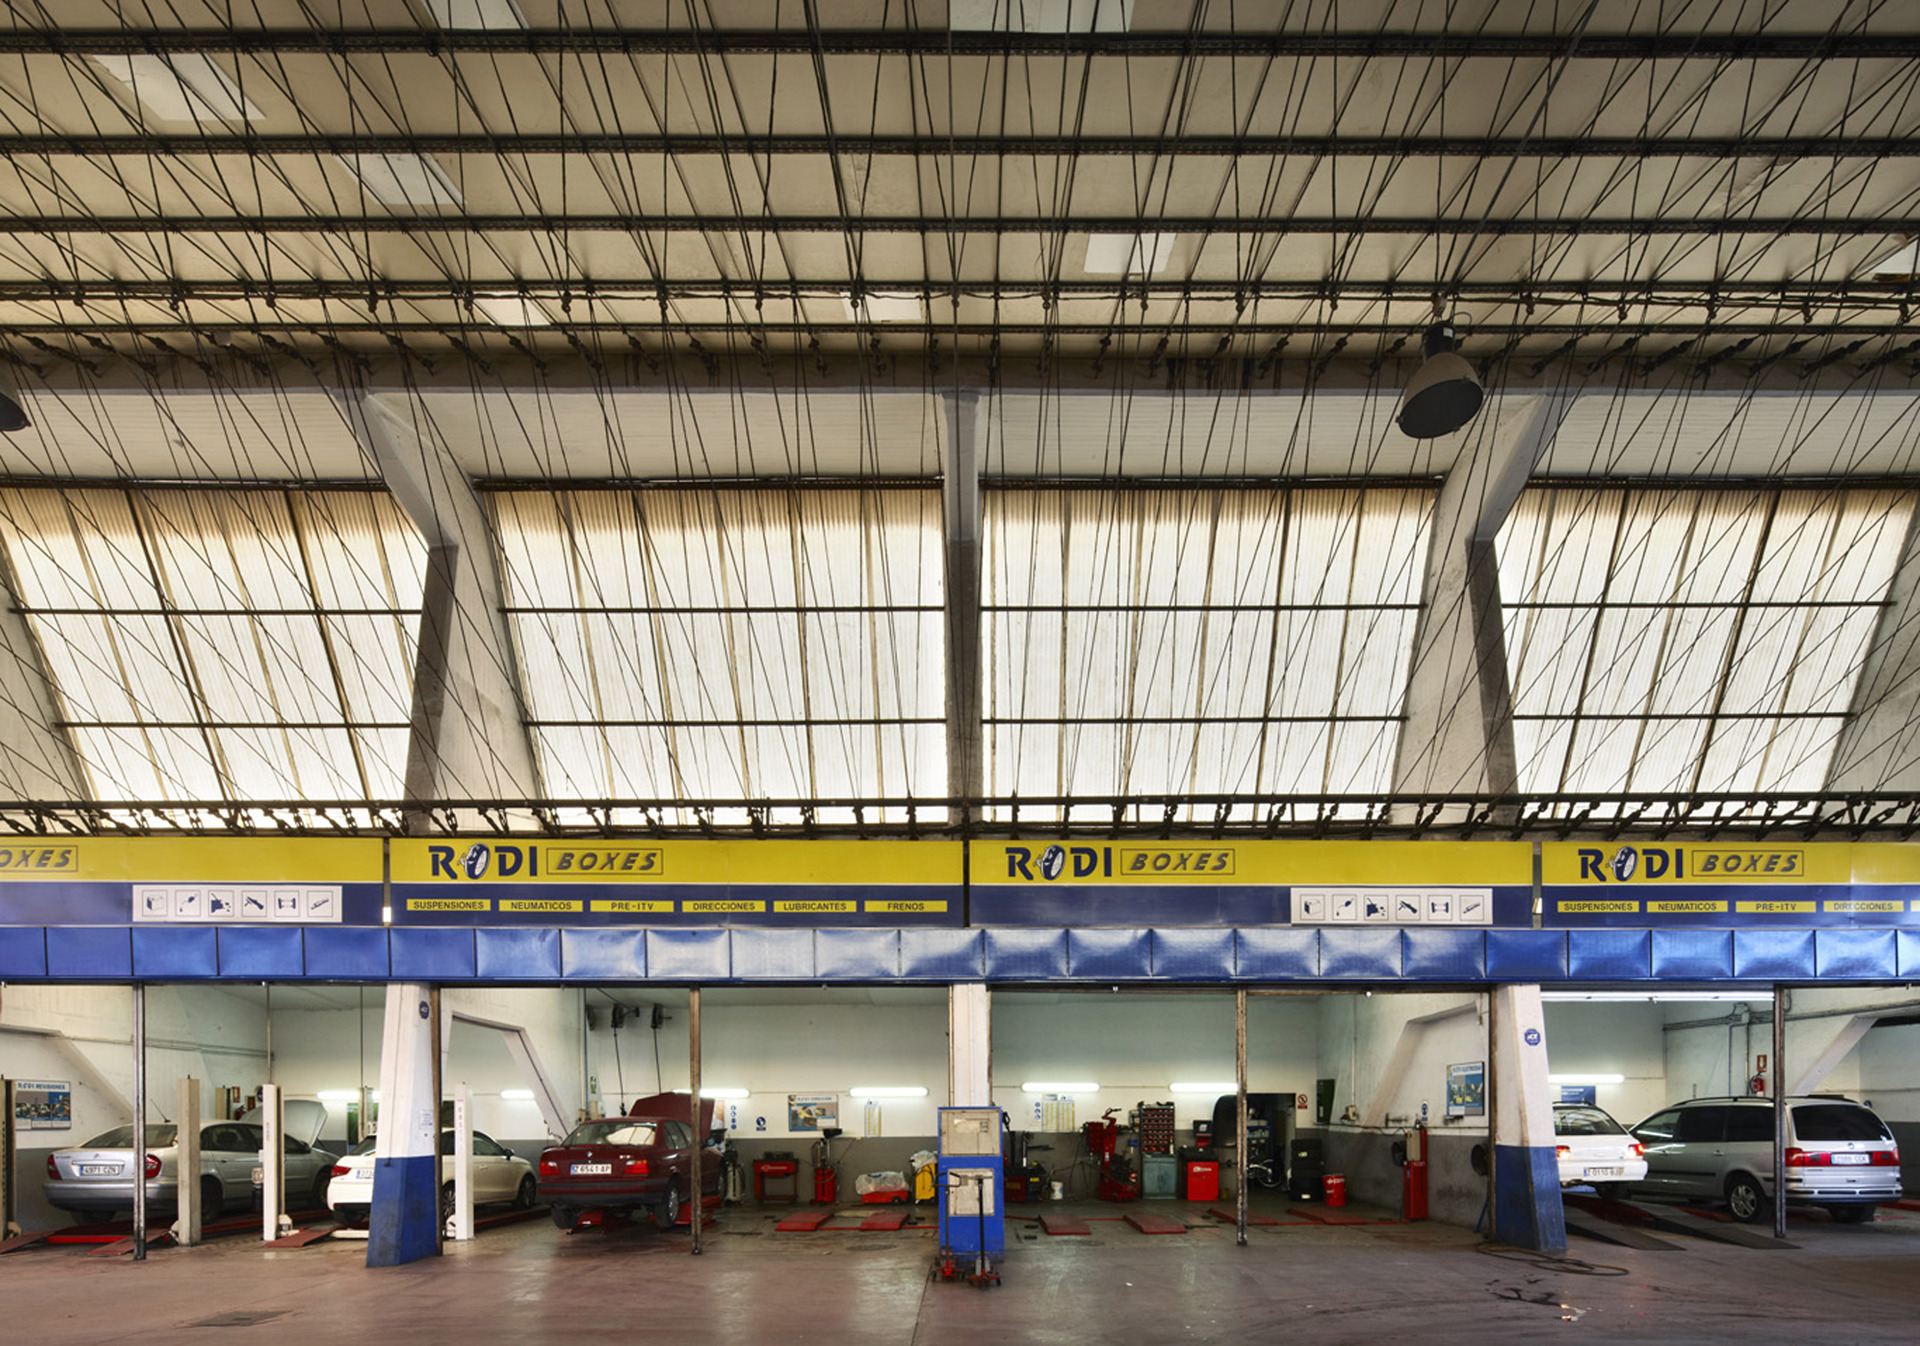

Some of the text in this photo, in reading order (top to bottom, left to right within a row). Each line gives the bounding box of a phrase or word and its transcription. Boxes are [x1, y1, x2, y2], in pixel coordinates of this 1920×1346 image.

[428, 843, 657, 880] RODI BOXES
[1005, 844, 1229, 881] RODI BOXES
[1577, 846, 1799, 882] RODI BOXES
[413, 901, 484, 910] SUSPENSIONES
[511, 902, 572, 910] NEUMATICOS
[611, 902, 654, 910] PRE-ITV
[693, 902, 755, 911] DIRECCIONES
[783, 902, 847, 911] LUBRICANTES
[888, 902, 925, 911] FRENOS
[1564, 902, 1633, 911] SUSPENSIONES
[1658, 902, 1717, 911] NEUMATICOS
[1755, 902, 1797, 911] PRE-ITV
